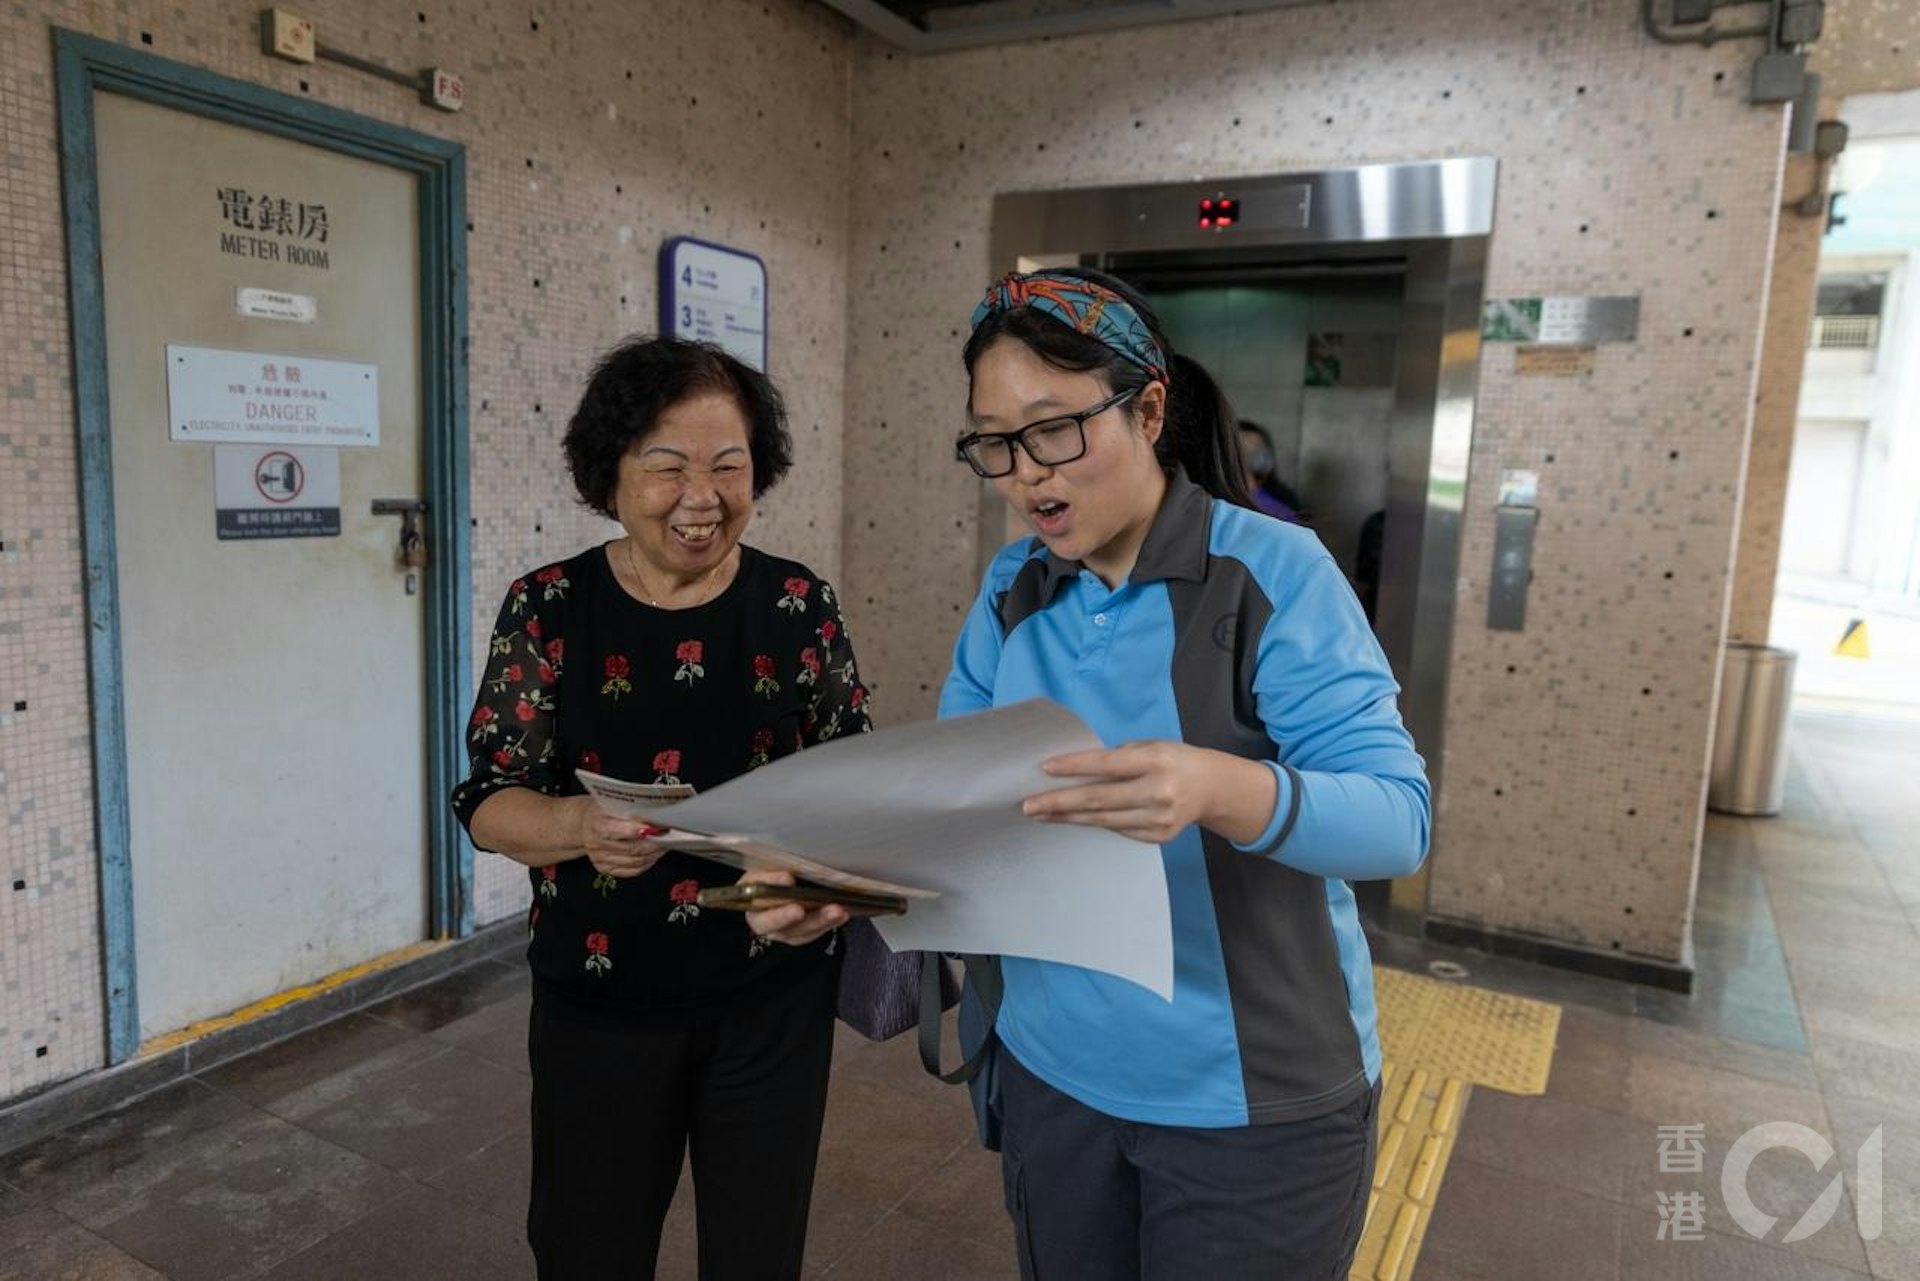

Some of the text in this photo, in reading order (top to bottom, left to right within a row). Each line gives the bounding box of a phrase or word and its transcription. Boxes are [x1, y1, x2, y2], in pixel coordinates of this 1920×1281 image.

[217, 187, 329, 244] 電錶房
[220, 232, 330, 270] METER ROOM
[682, 264, 692, 288] 4
[682, 304, 692, 328] 3
[245, 402, 318, 422] DANGER
